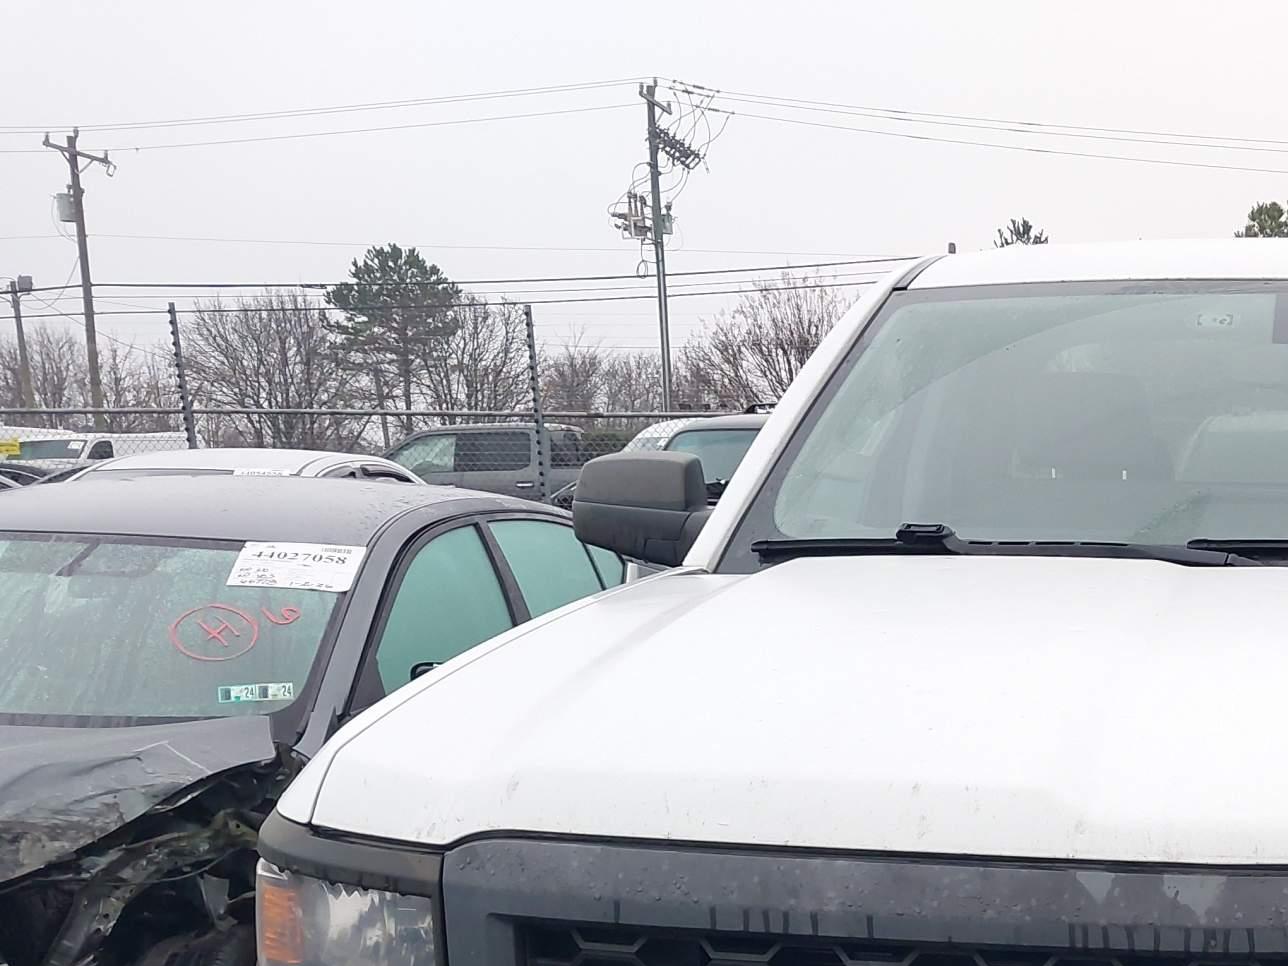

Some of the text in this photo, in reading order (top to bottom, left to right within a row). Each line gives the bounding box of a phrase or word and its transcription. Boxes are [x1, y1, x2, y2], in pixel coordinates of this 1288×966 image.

[251, 551, 347, 565] 44027058
[244, 685, 293, 698] 24 24
